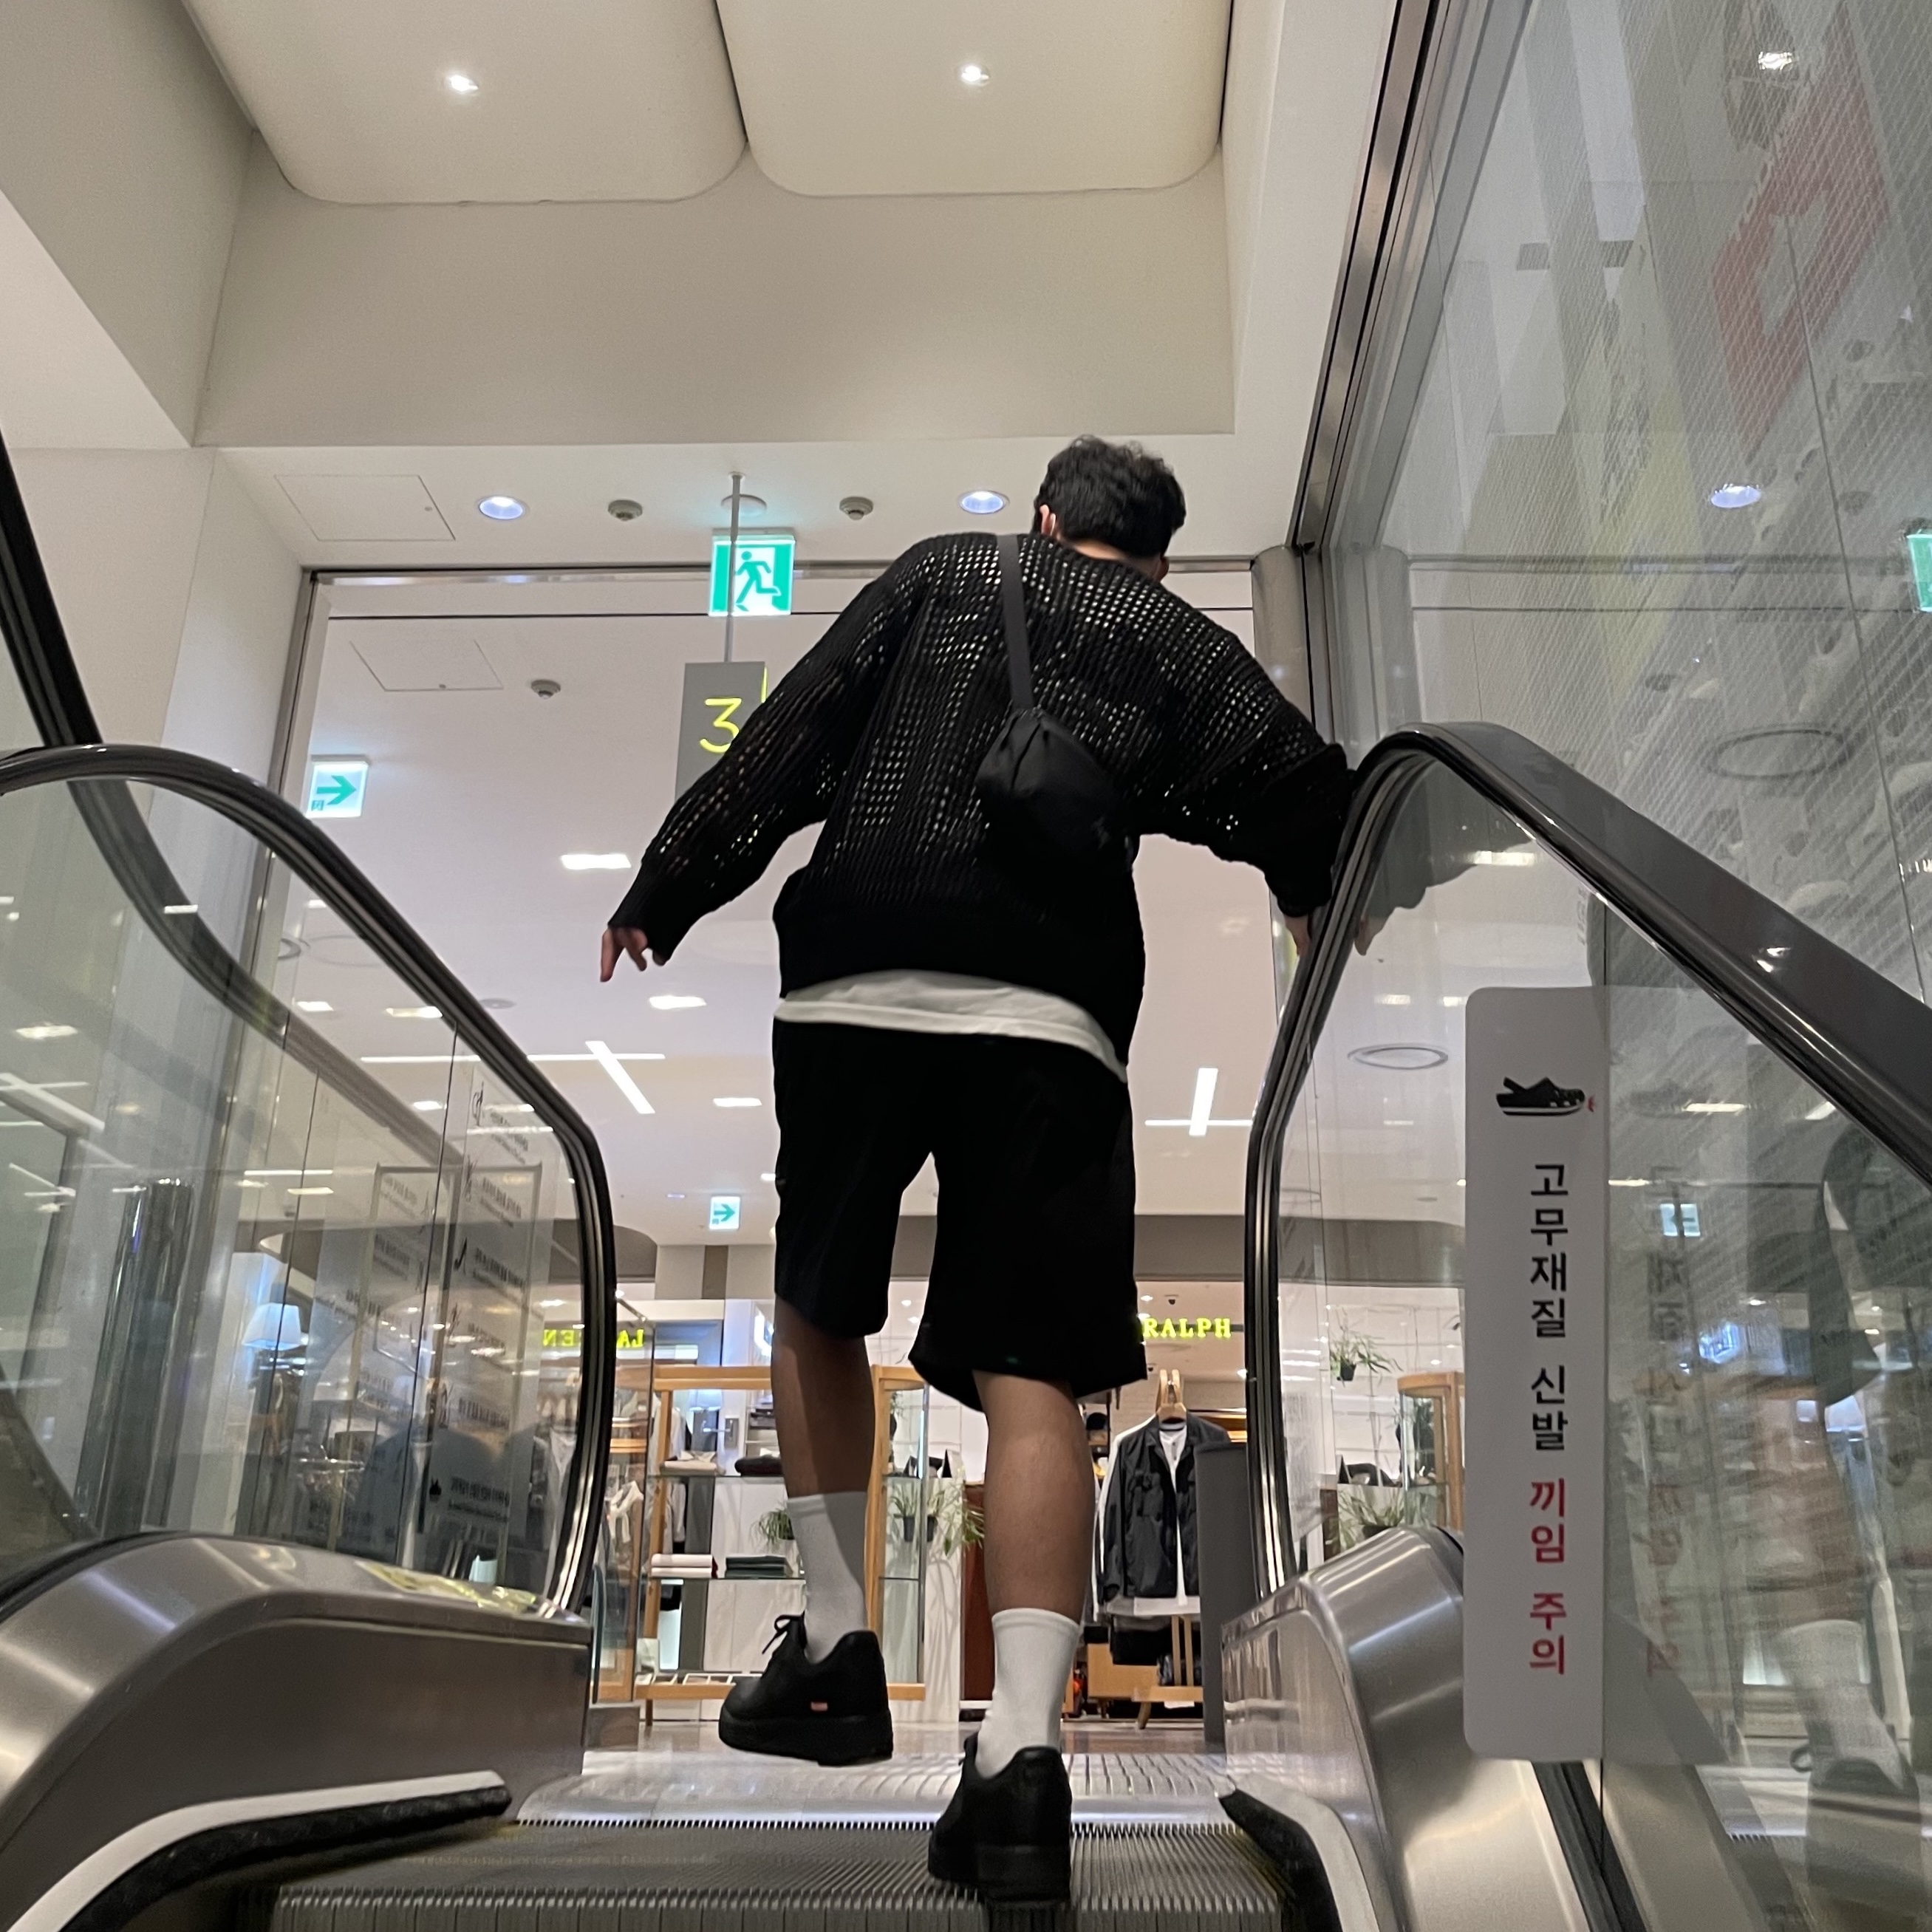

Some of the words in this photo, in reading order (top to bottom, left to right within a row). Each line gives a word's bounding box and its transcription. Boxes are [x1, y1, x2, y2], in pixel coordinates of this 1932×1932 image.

[700, 697, 743, 754] 3
[1530, 1164, 1569, 1338] 고무재질
[1143, 1317, 1232, 1339] RALPH
[1531, 1365, 1569, 1451] 신발
[1529, 1478, 1565, 1563] 끼임
[1529, 1593, 1567, 1675] 주의
